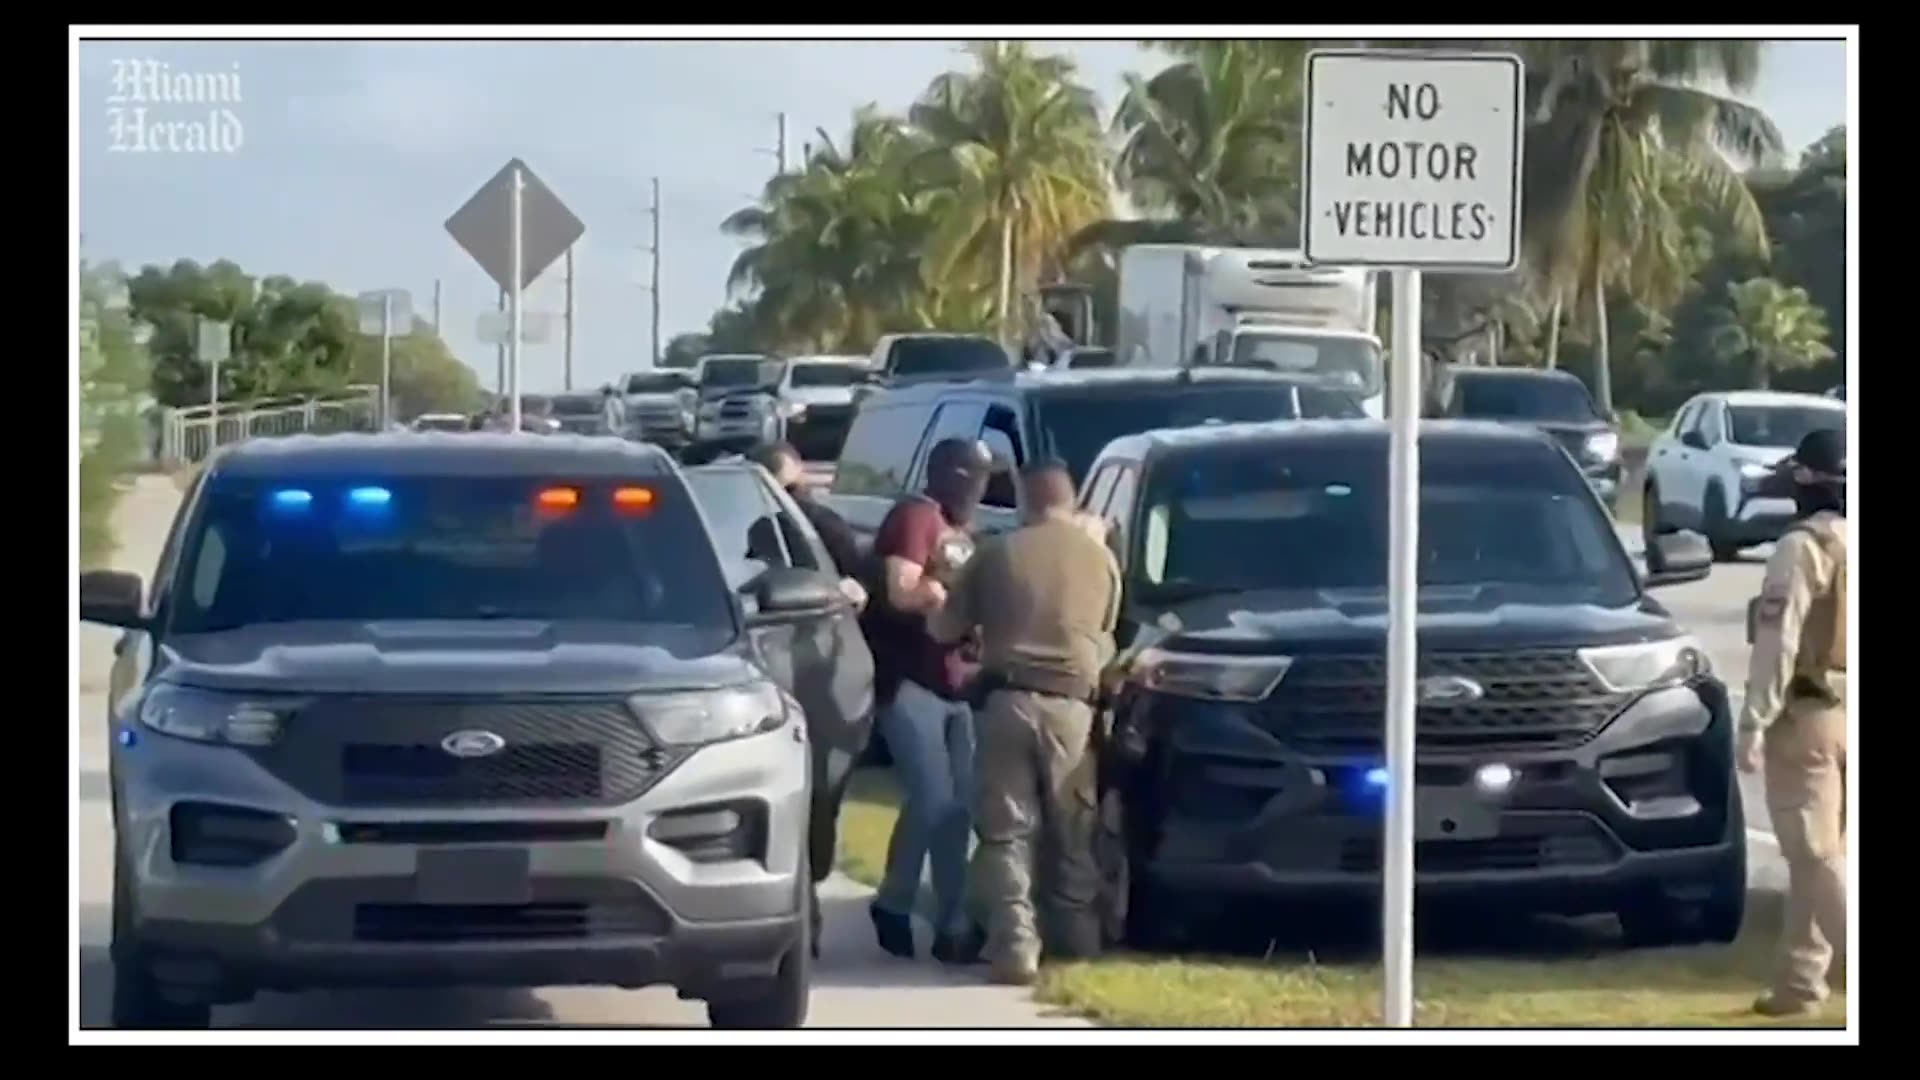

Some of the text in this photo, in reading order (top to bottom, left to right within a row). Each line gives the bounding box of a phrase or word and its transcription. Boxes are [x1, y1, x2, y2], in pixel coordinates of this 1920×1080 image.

[1387, 83, 1439, 120] NO
[1346, 142, 1477, 181] MOTOR
[1334, 201, 1486, 240] VEHICLES
